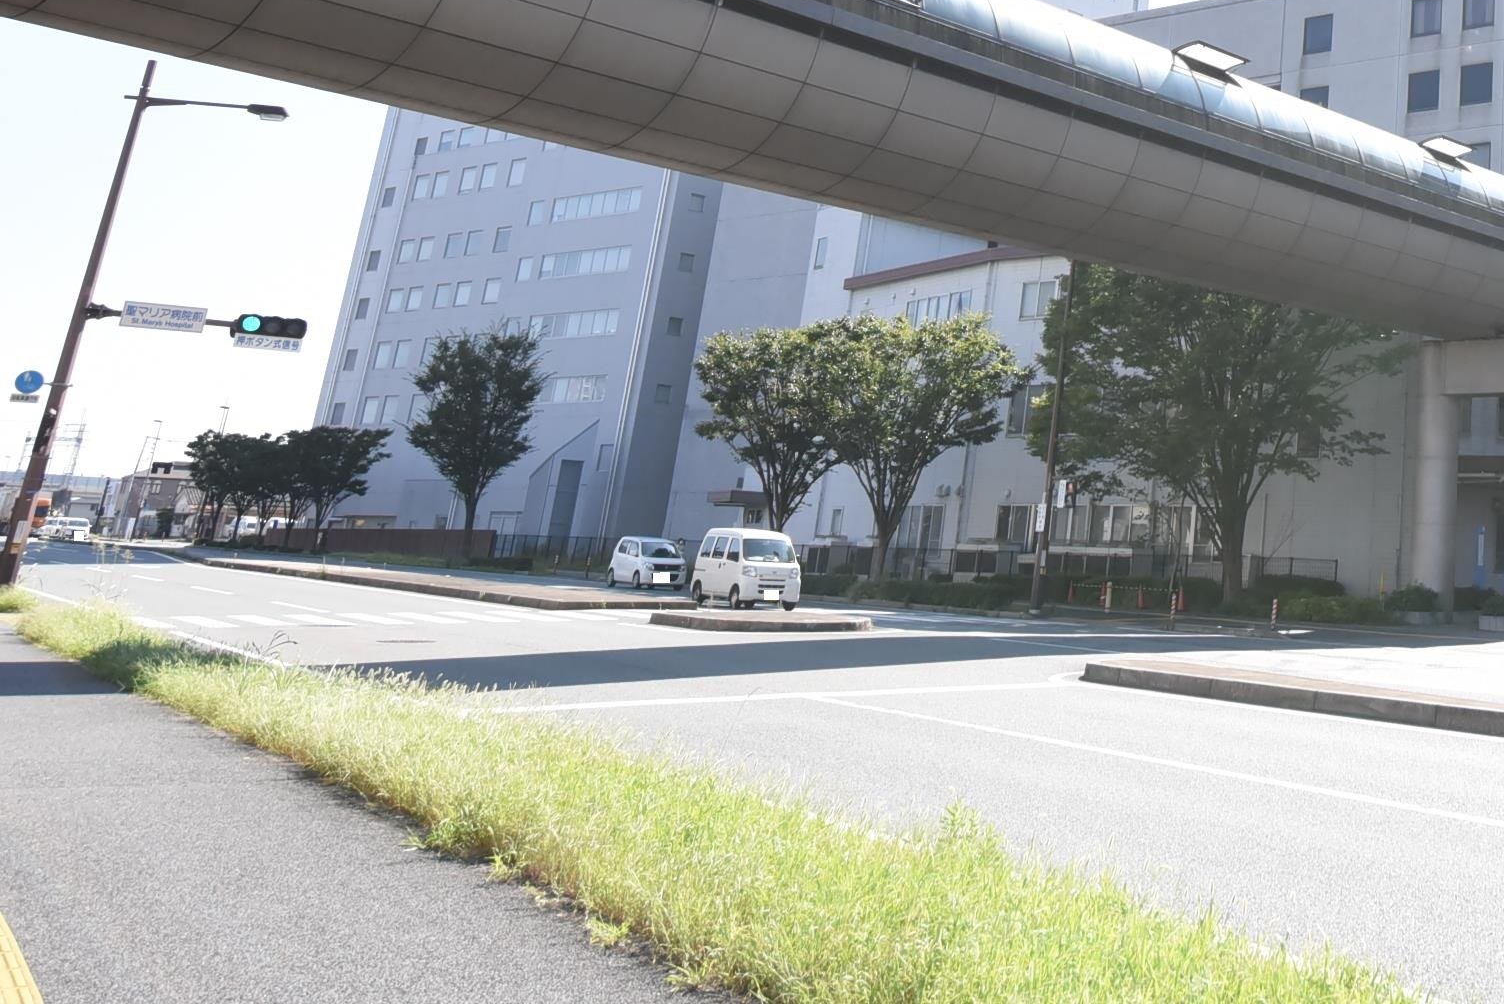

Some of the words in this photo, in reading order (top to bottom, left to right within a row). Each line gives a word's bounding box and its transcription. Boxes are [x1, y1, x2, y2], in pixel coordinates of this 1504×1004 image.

[126, 305, 204, 323] 聖マリア病院前
[165, 321, 194, 329] Hospital
[236, 336, 300, 351] 押ボタン式信号
